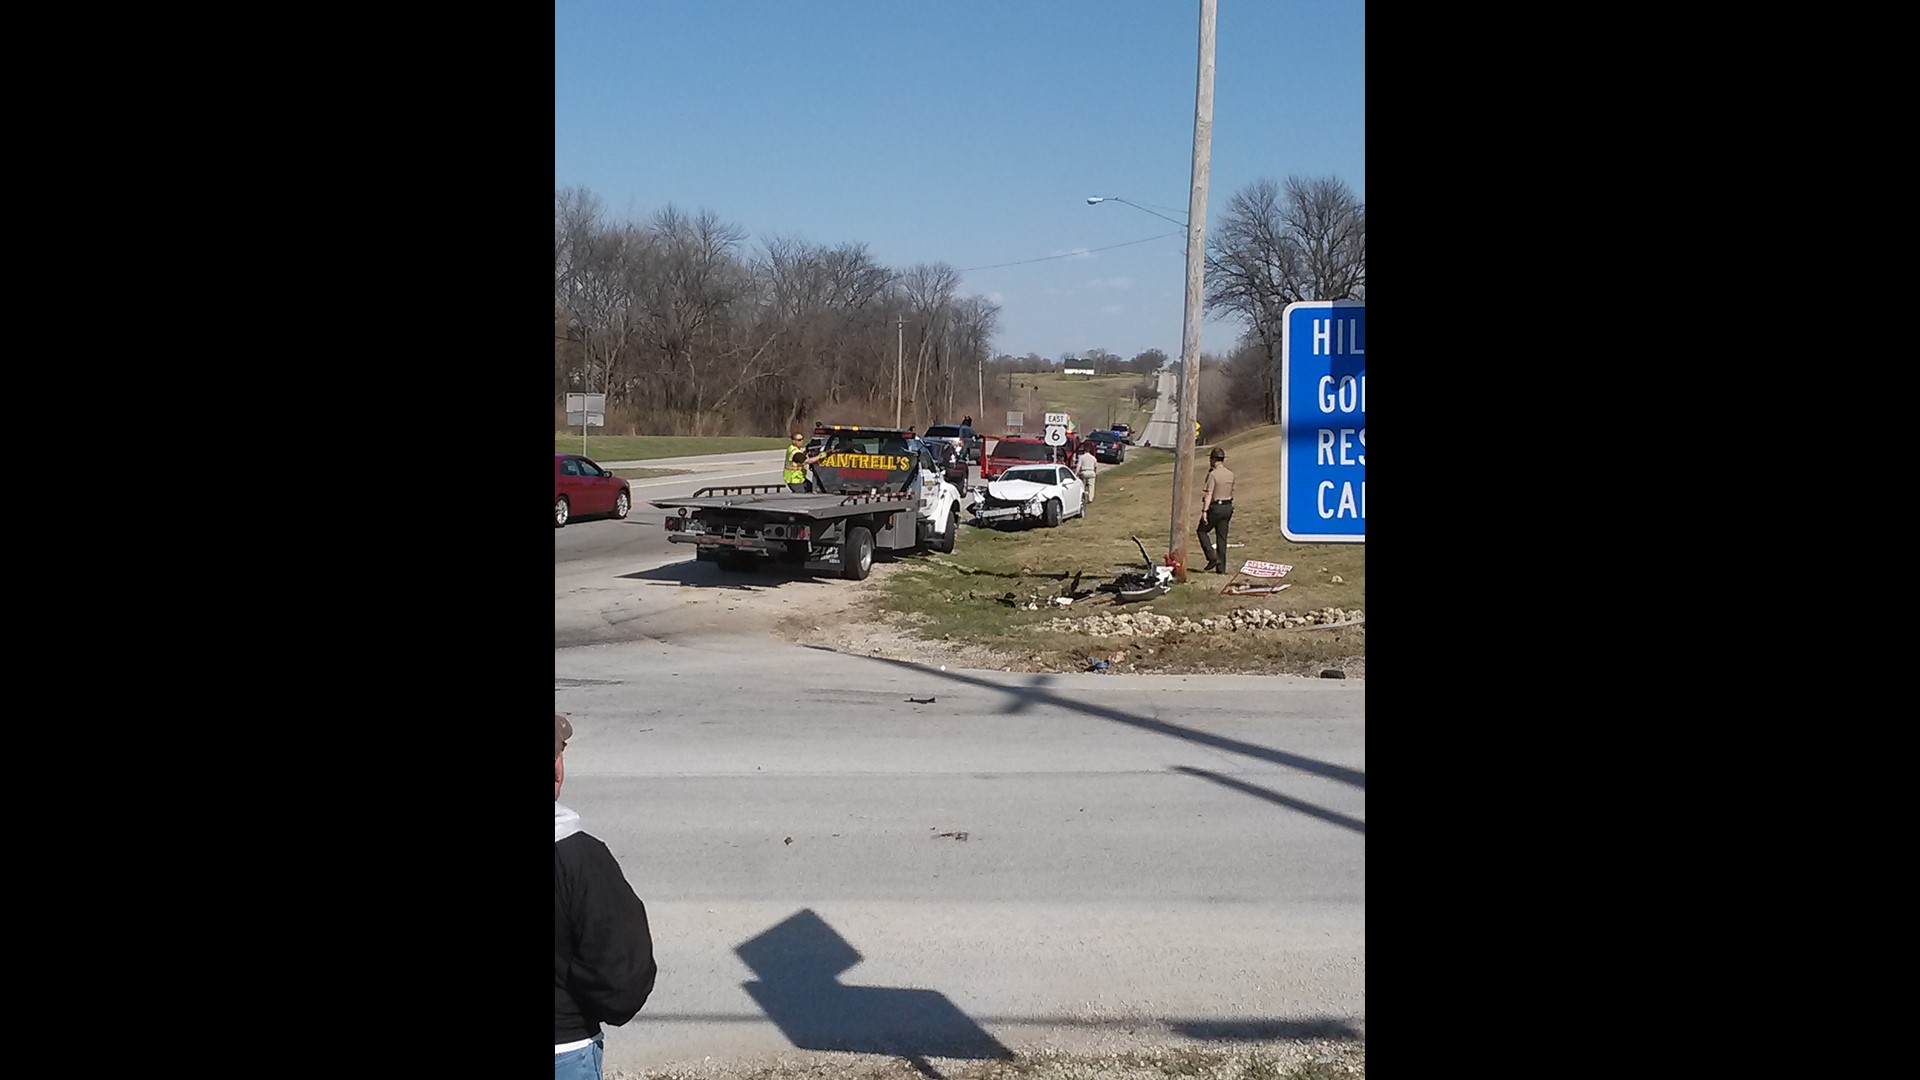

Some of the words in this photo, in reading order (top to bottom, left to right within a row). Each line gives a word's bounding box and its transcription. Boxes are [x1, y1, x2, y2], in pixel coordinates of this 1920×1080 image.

[1318, 375, 1365, 414] GO
[1051, 429, 1060, 441] 6
[1317, 480, 1365, 519] CA
